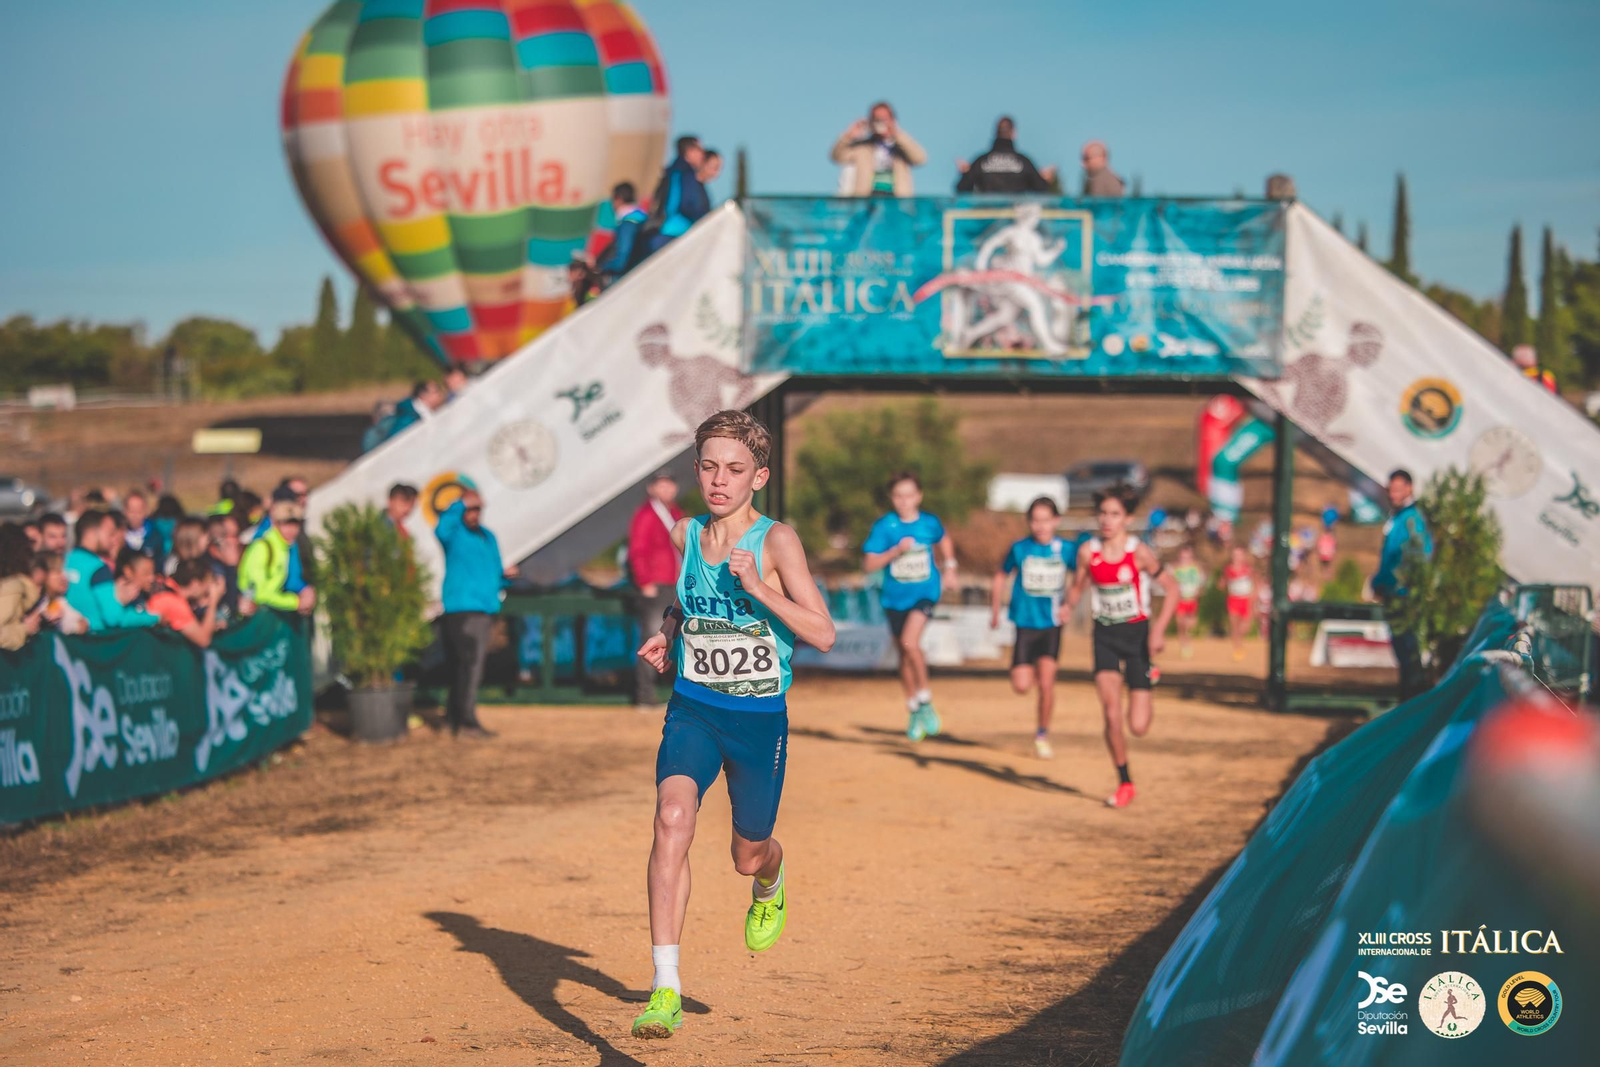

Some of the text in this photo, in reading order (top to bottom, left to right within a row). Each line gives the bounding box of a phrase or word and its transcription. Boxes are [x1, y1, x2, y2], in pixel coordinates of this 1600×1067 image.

[402, 113, 543, 153] Hay otra
[378, 148, 583, 219] Sevilla.
[684, 590, 755, 621] nerja
[693, 645, 773, 676] 8028
[121, 706, 180, 767] Sevilla
